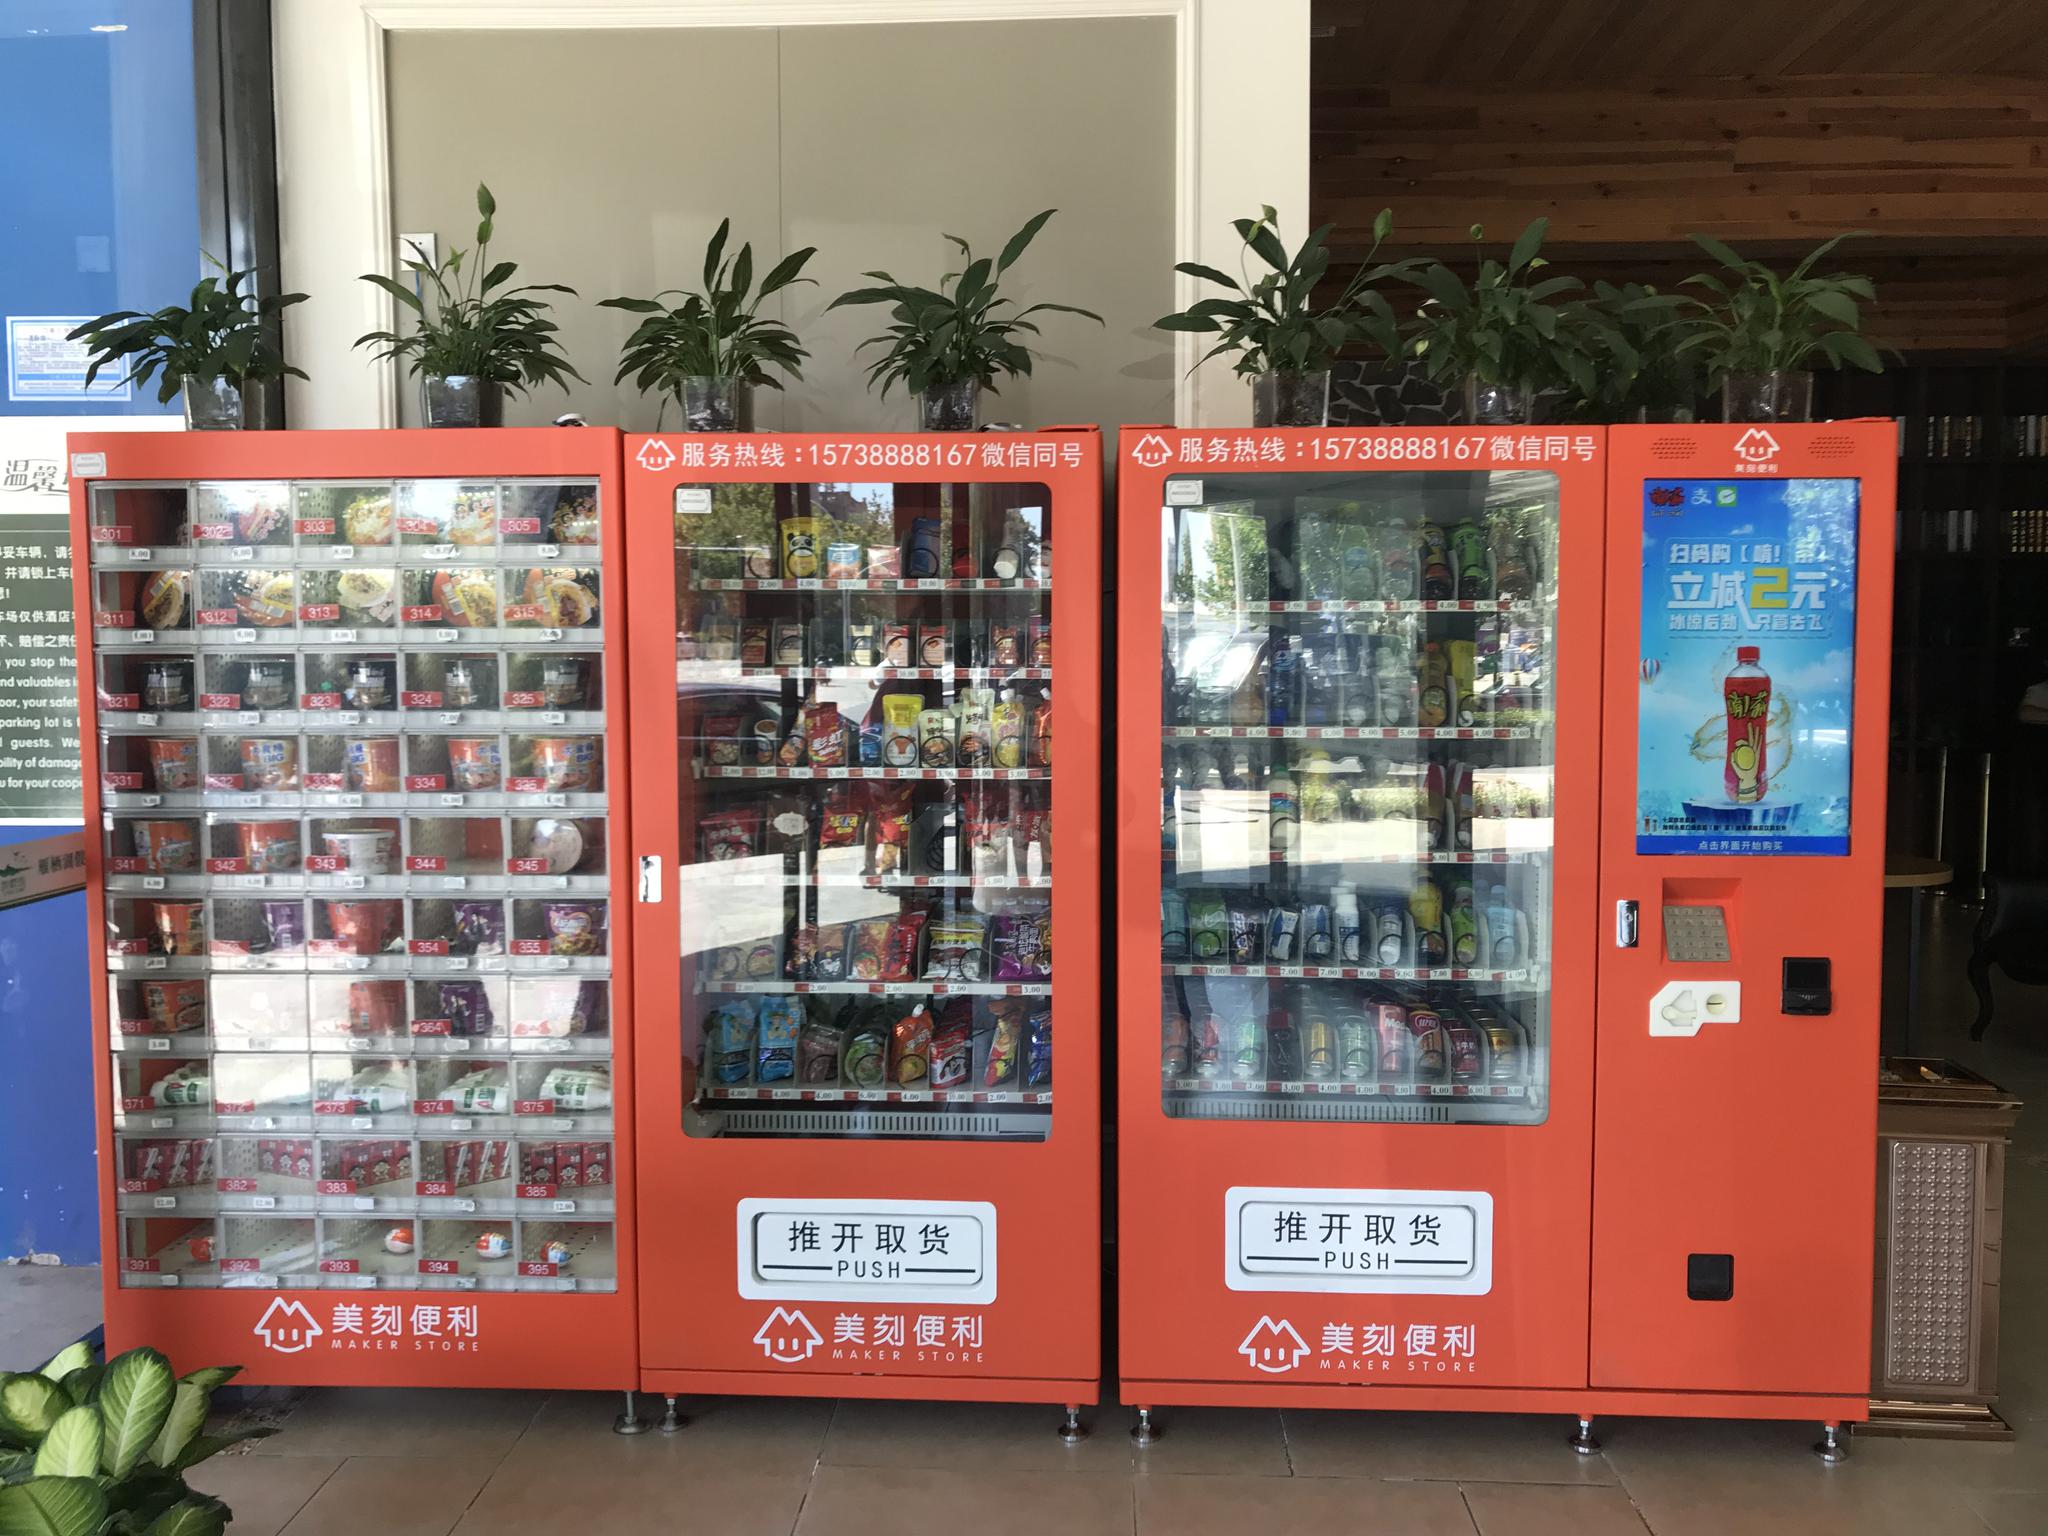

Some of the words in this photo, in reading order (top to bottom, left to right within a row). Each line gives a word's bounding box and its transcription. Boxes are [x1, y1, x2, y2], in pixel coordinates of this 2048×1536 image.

[3, 459, 69, 492] 温馨
[304, 522, 326, 532] 303
[508, 521, 530, 531] 305
[102, 529, 121, 539] 301
[1667, 567, 1828, 612] 立减2元
[0, 610, 76, 623] 场仅供酒店
[205, 612, 227, 622] 312
[308, 607, 330, 618] 313
[410, 609, 432, 619] 314
[103, 614, 124, 624] 311
[5, 658, 26, 669] you
[30, 656, 55, 669] stop
[16, 676, 71, 688] valuables
[209, 697, 230, 707] 322
[411, 694, 432, 704] 324
[512, 694, 535, 704] 325
[22, 700, 47, 711] your
[44, 717, 59, 728] lot
[63, 717, 73, 728] is
[10, 738, 53, 750] guests.
[61, 738, 80, 748] We
[25, 756, 37, 768] of
[8, 778, 23, 788] for
[25, 780, 50, 791] your
[111, 776, 132, 786] 331
[414, 778, 436, 788] 334
[1698, 840, 1784, 851] 点击界面开始购买
[115, 860, 135, 870] 341
[215, 861, 236, 871] 342
[315, 858, 336, 869] 343
[415, 858, 436, 869] 344
[516, 861, 538, 871] 345
[417, 943, 439, 953] 354
[519, 943, 540, 953] 355
[121, 1022, 142, 1032] 361
[1431, 1086, 1449, 1094] 4.00
[124, 1099, 145, 1109] 371
[324, 1103, 345, 1112] 373
[422, 1102, 444, 1113] 374
[522, 1102, 544, 1112] 375
[127, 1181, 147, 1191] 381
[226, 1181, 247, 1191] 382
[326, 1182, 347, 1193] 383
[425, 1183, 446, 1194] 384
[525, 1186, 547, 1197] 385
[1274, 1210, 1441, 1246] 推开取货
[788, 1220, 950, 1255] 推开取货
[130, 1260, 150, 1270] 391
[229, 1260, 250, 1271] 392
[1324, 1251, 1389, 1270] PUSH
[329, 1261, 350, 1272] 393
[428, 1262, 449, 1273] 394
[527, 1264, 549, 1275] 395
[837, 1260, 900, 1278] PUSH
[332, 1303, 478, 1337] 美刻便利
[833, 1313, 983, 1348] 美刻便利
[1321, 1322, 1475, 1357] 美刻便利
[331, 1339, 399, 1350] MAKER
[415, 1340, 479, 1352] STORE
[832, 1350, 901, 1361] MAKER
[918, 1351, 983, 1363] STORE
[1320, 1359, 1390, 1371] MAKER
[1408, 1361, 1476, 1373] STORE
